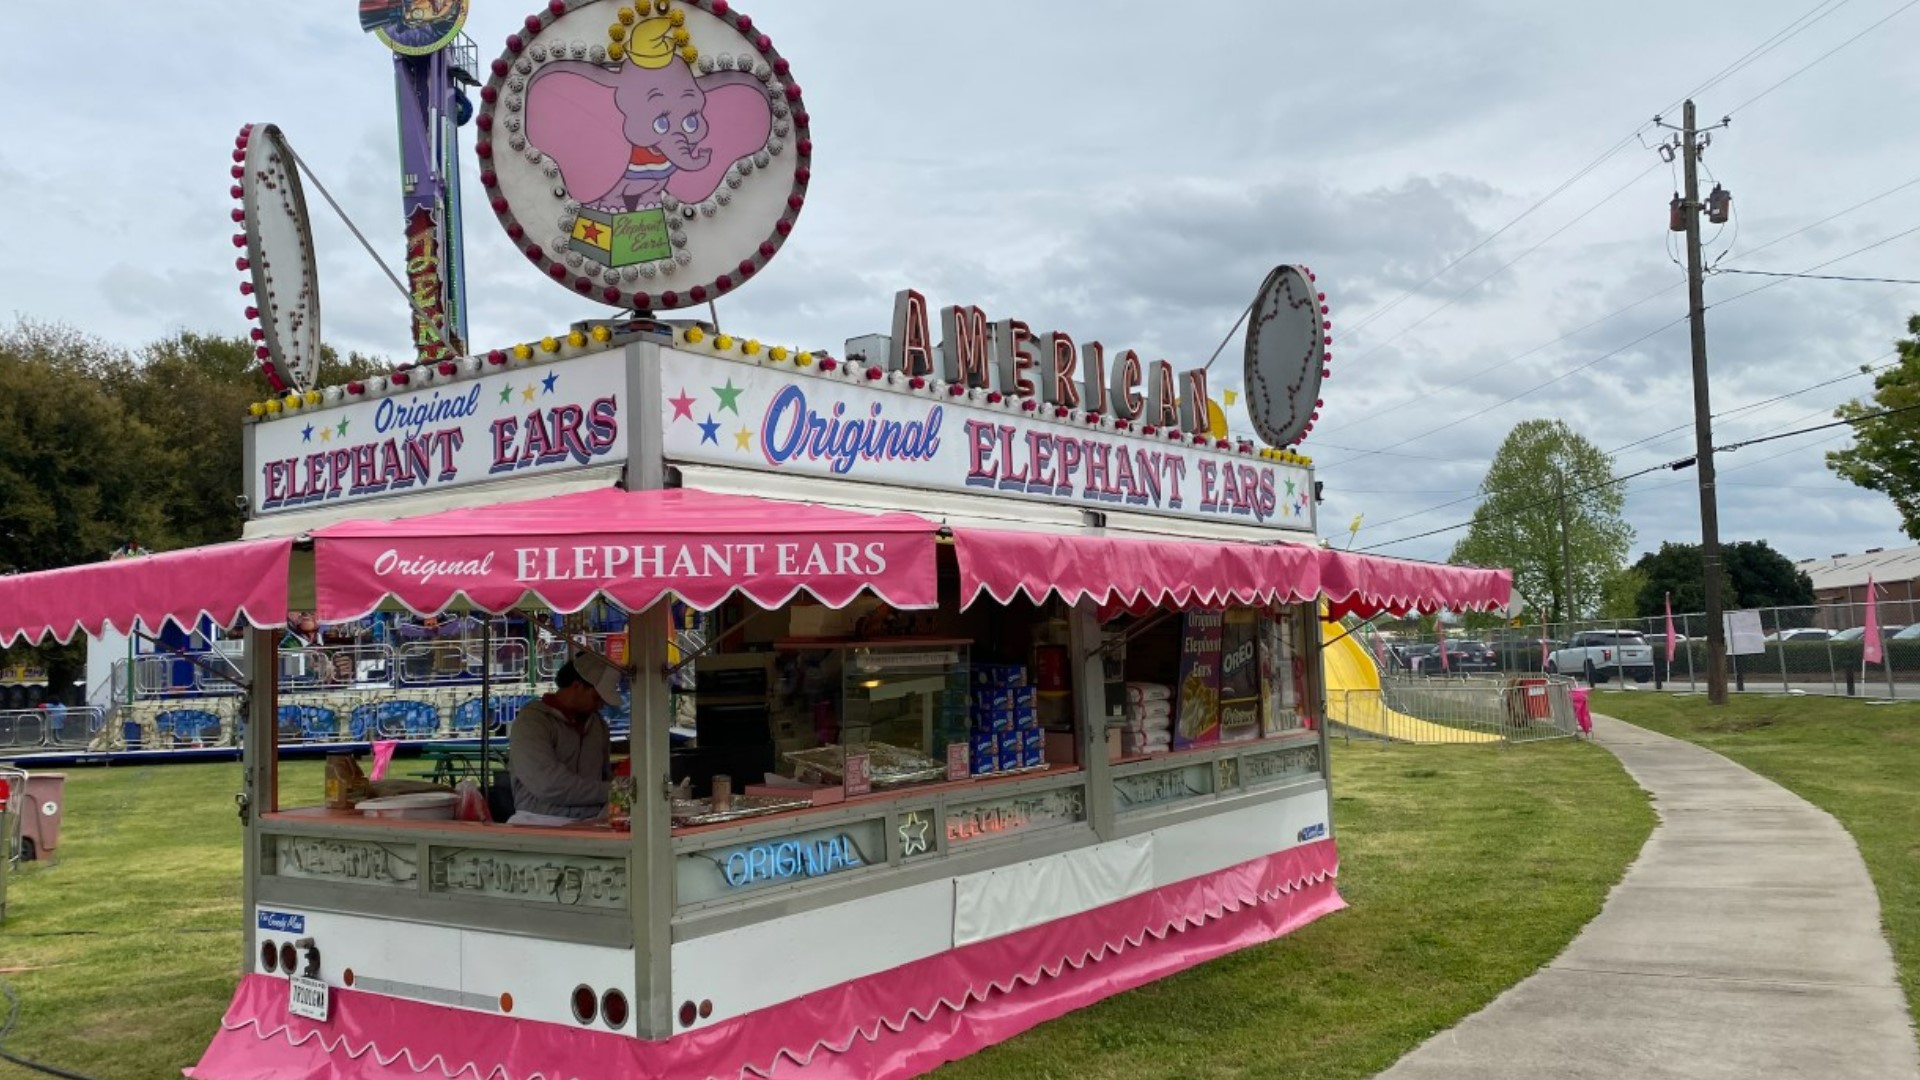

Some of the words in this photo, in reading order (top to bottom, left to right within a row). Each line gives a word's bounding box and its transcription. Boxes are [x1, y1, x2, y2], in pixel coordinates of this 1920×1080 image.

[889, 288, 1211, 434] AMERICAN
[375, 382, 482, 440] Original
[760, 383, 944, 474] Original
[262, 426, 465, 510] ELEPHANT
[488, 394, 619, 474] EARS
[964, 417, 1188, 508] ELEPHANT
[1198, 460, 1277, 523] EARS
[373, 548, 495, 584] Original
[513, 543, 765, 582] ELEPHANT
[775, 541, 887, 576] EARS
[1192, 660, 1213, 678] Ears
[1223, 640, 1254, 674] OREO
[727, 834, 860, 887] ORIGINAL
